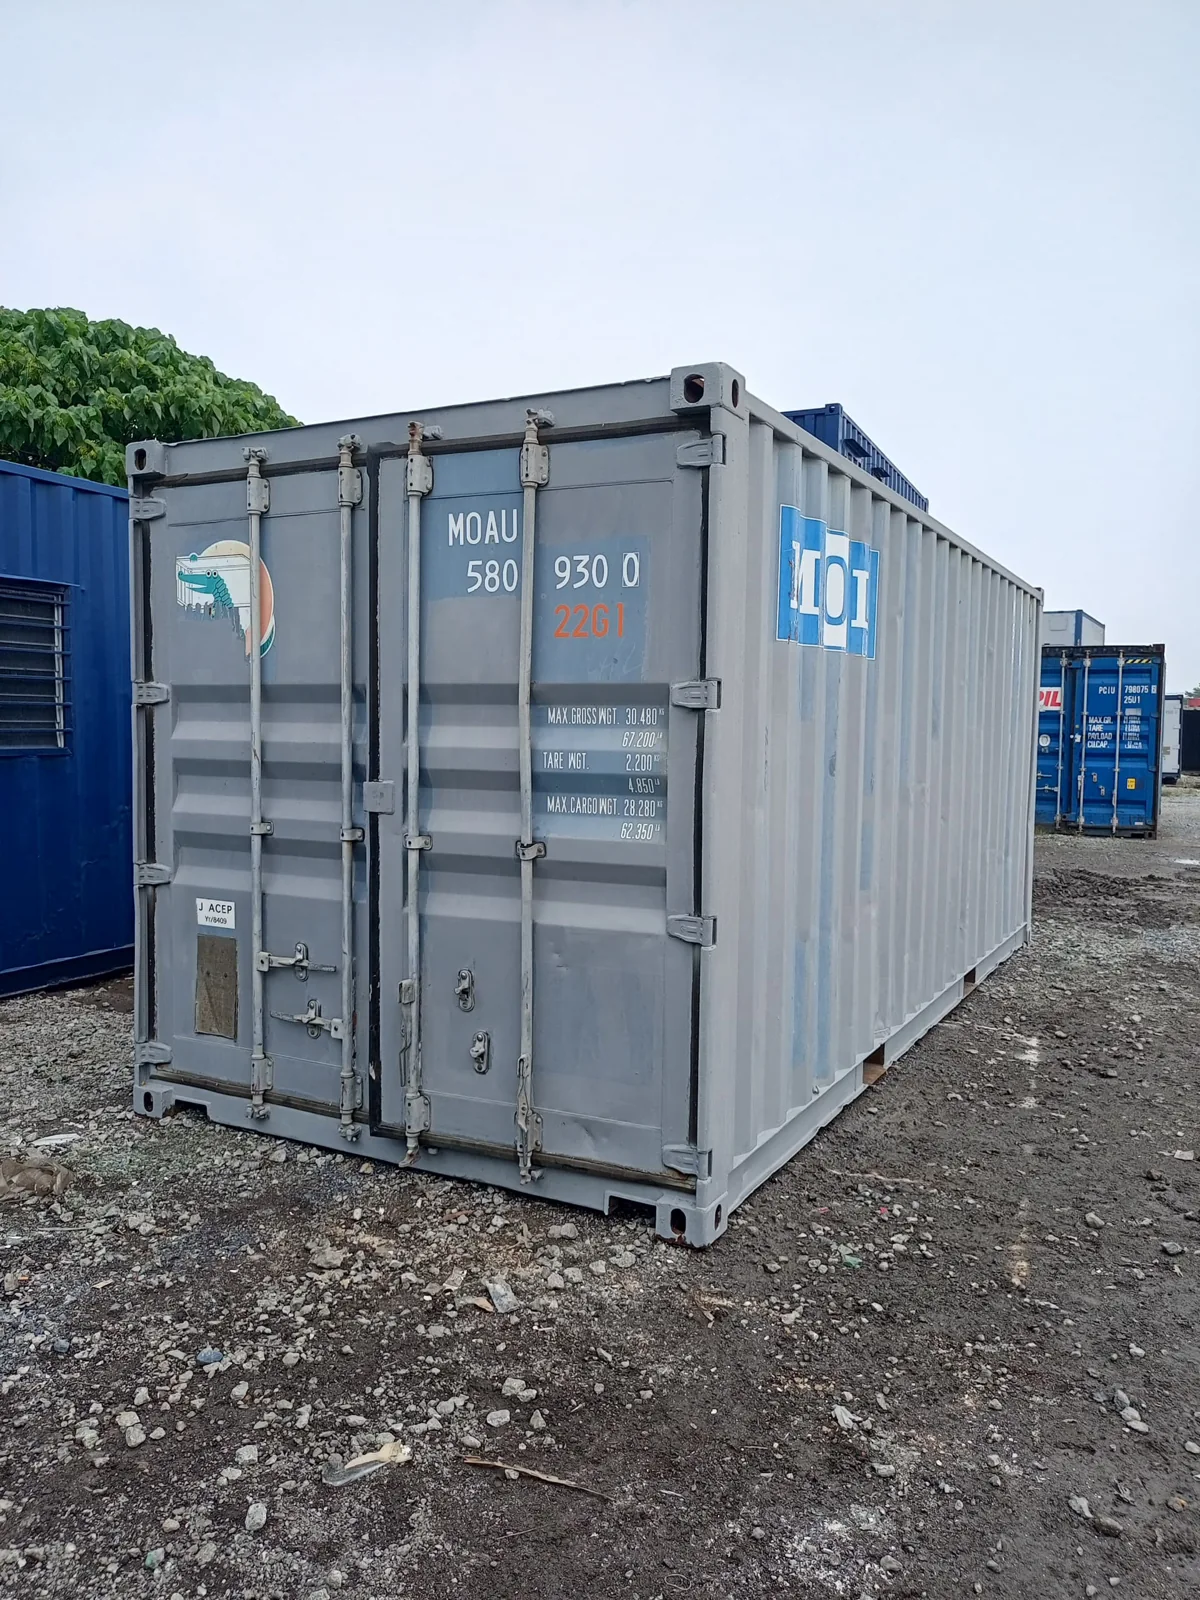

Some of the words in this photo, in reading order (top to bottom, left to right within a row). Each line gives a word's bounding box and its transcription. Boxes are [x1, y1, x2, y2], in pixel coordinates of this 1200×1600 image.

[448, 508, 518, 546] MOAU
[467, 559, 519, 593] 580
[554, 554, 609, 590] 930
[622, 552, 640, 587] 0
[554, 602, 625, 638] 22G1
[1098, 686, 1116, 695] PCIU
[1124, 684, 1149, 694] 798075
[625, 707, 658, 725] 30.480
[1087, 732, 1113, 740] PAYLOAD
[1088, 724, 1104, 732] TARE
[622, 731, 656, 748] 67.200
[543, 752, 564, 769] TARE
[568, 752, 590, 770] WGT.
[625, 753, 653, 772] 2.200
[628, 777, 655, 794] 4.850
[624, 799, 656, 817] 28.280
[620, 822, 654, 840] 62.350
[208, 903, 233, 914] ACEP
